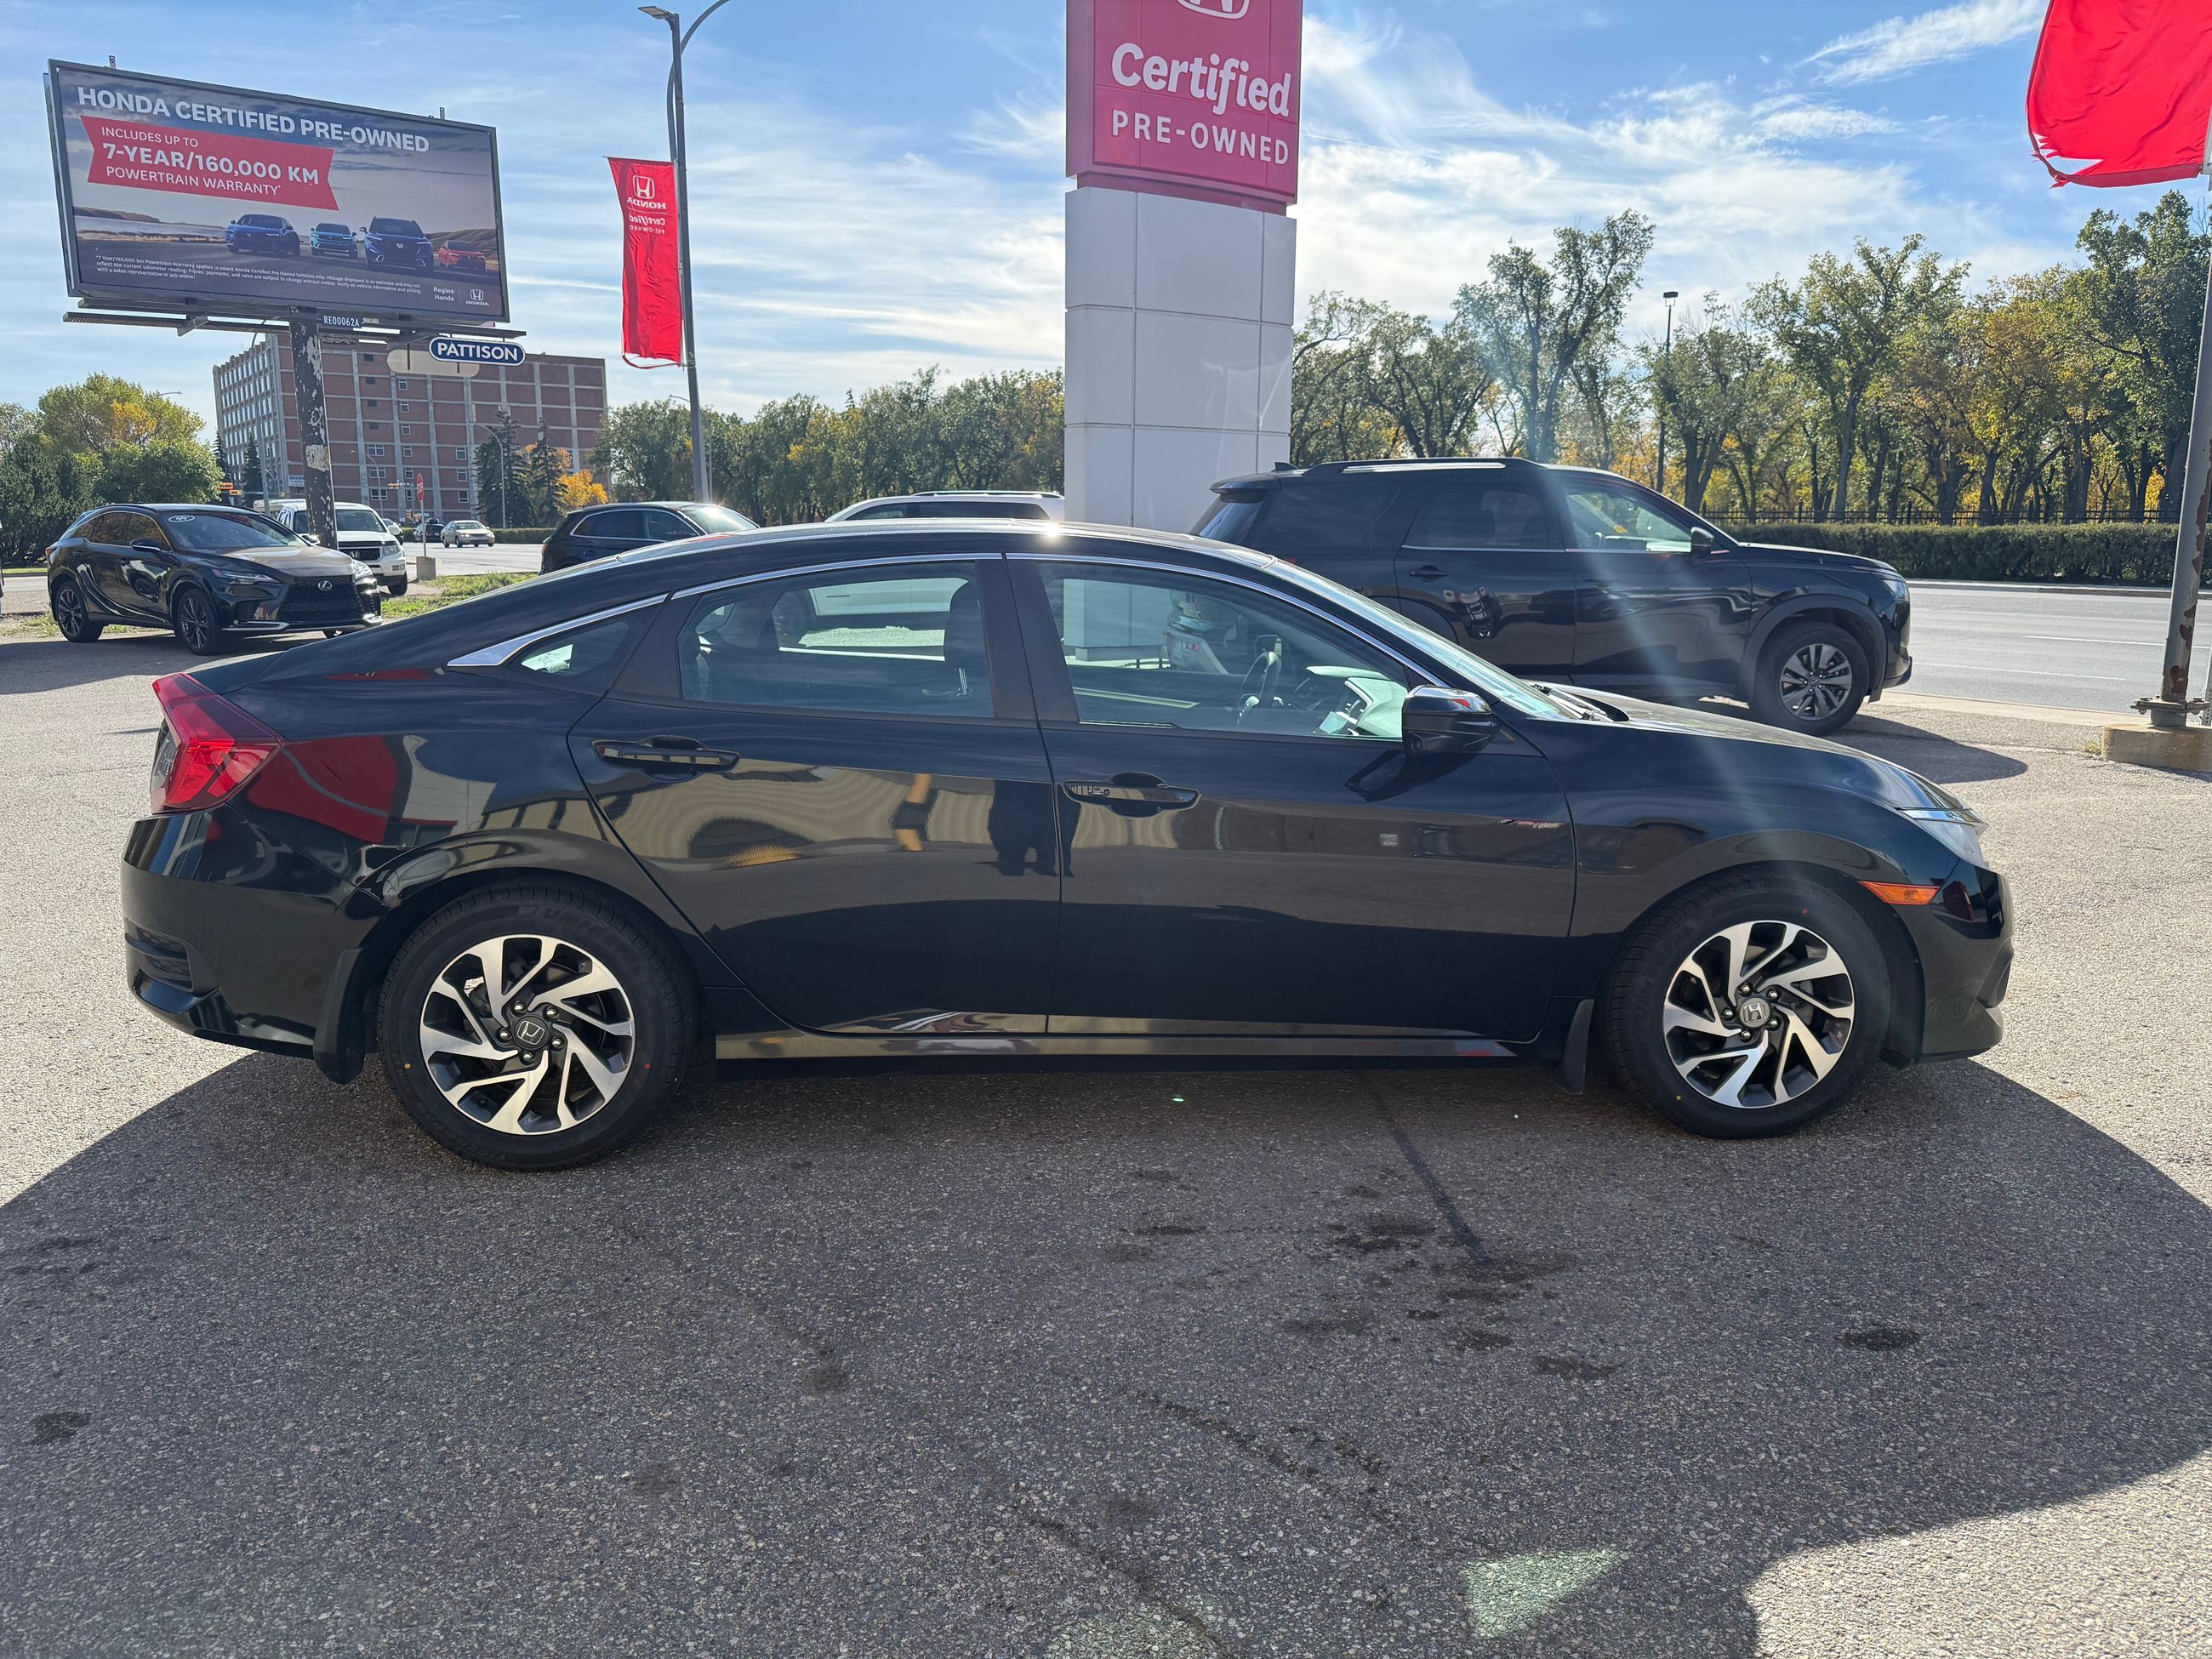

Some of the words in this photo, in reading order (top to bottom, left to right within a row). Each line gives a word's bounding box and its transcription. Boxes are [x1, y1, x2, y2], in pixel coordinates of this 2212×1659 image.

[1111, 43, 1291, 117] Certified
[77, 87, 170, 117] HONDA
[174, 101, 296, 134] CERTIFIED
[300, 118, 430, 152] PRE-OWNED
[101, 127, 162, 143] INCLUDES
[164, 134, 180, 145] UP
[183, 137, 198, 147] TO
[1112, 109, 1289, 165] PRE-OWNED
[103, 142, 282, 180] 7-YEAR/160,000
[288, 166, 319, 185] KM
[106, 166, 199, 186] POWERTRAIN
[433, 286, 454, 294] Regina
[323, 315, 360, 327] RE00062A
[437, 341, 518, 362] PATTISON
